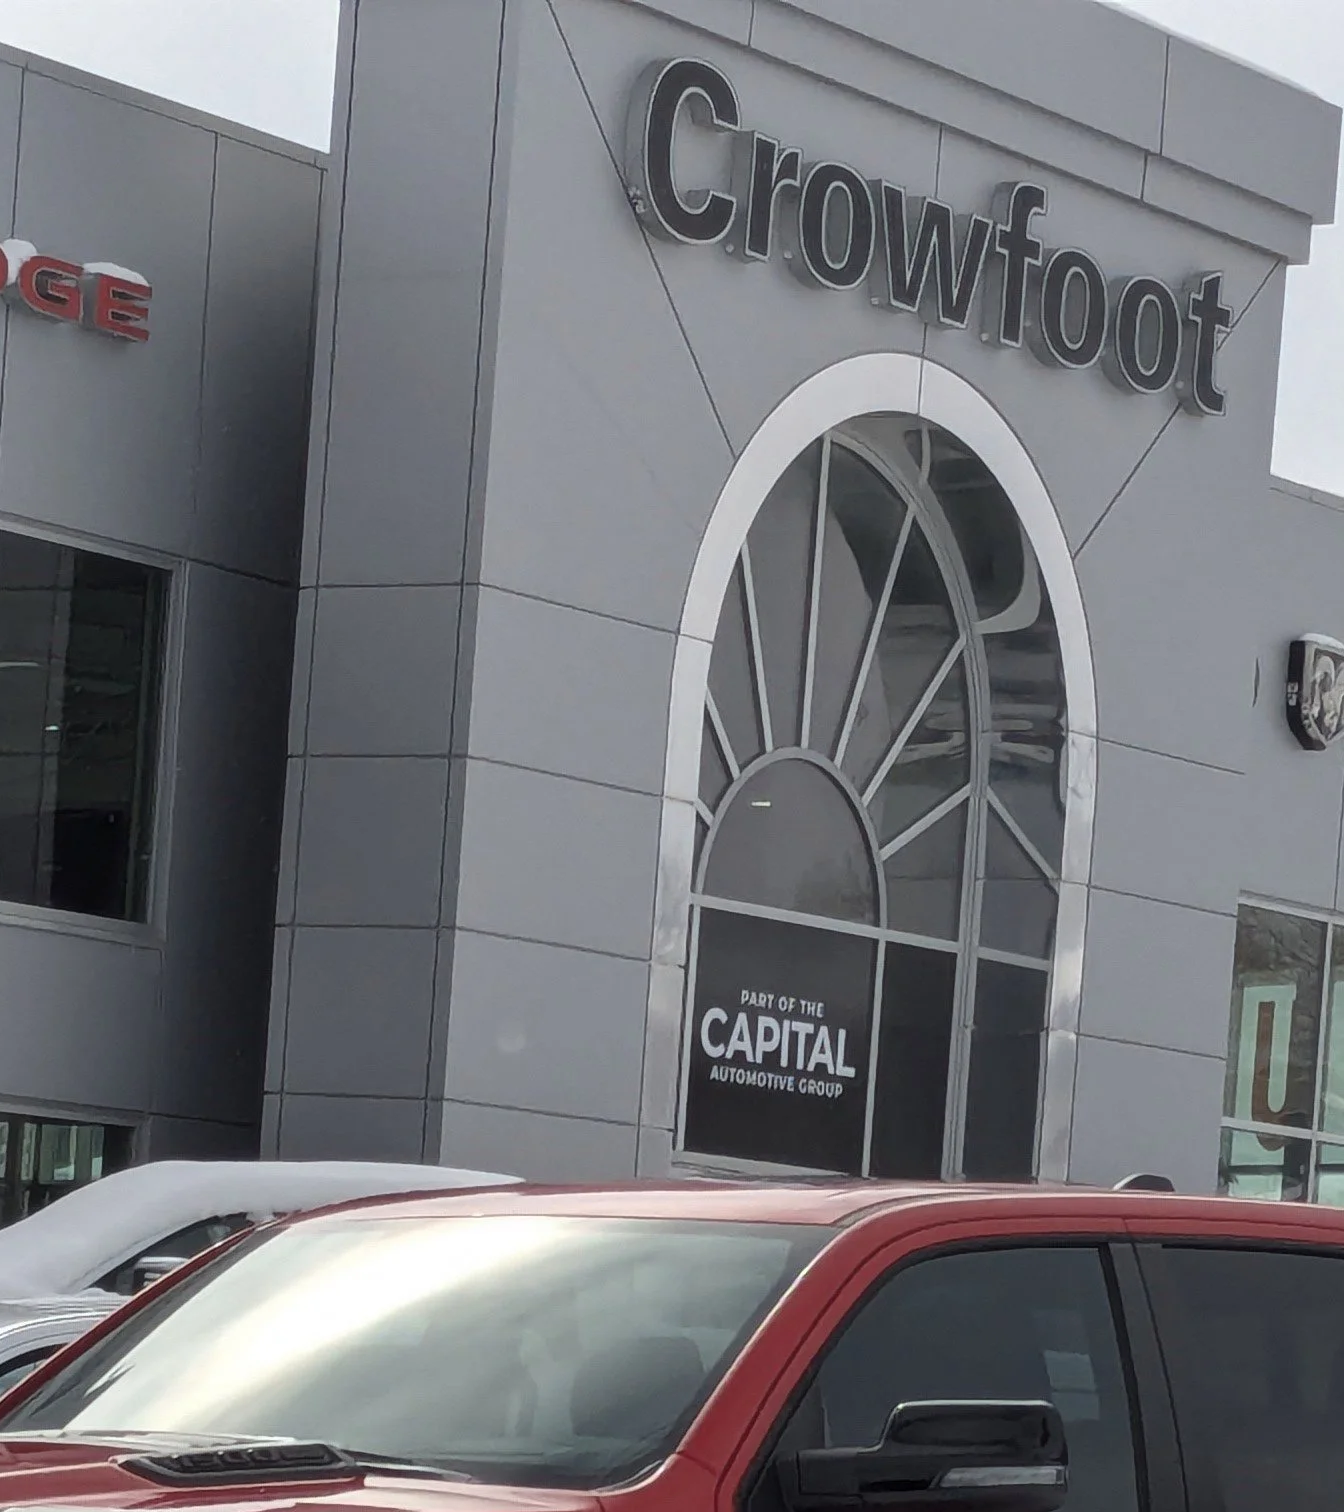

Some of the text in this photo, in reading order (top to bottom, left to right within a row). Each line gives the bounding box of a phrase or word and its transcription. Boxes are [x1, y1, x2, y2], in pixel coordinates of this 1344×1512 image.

[641, 56, 1233, 417] Crowfoot
[740, 989, 825, 1018] PART OF THE
[700, 1006, 856, 1079] CAPITAL
[709, 1064, 844, 1099] AUTOMOTIVE GROUP
